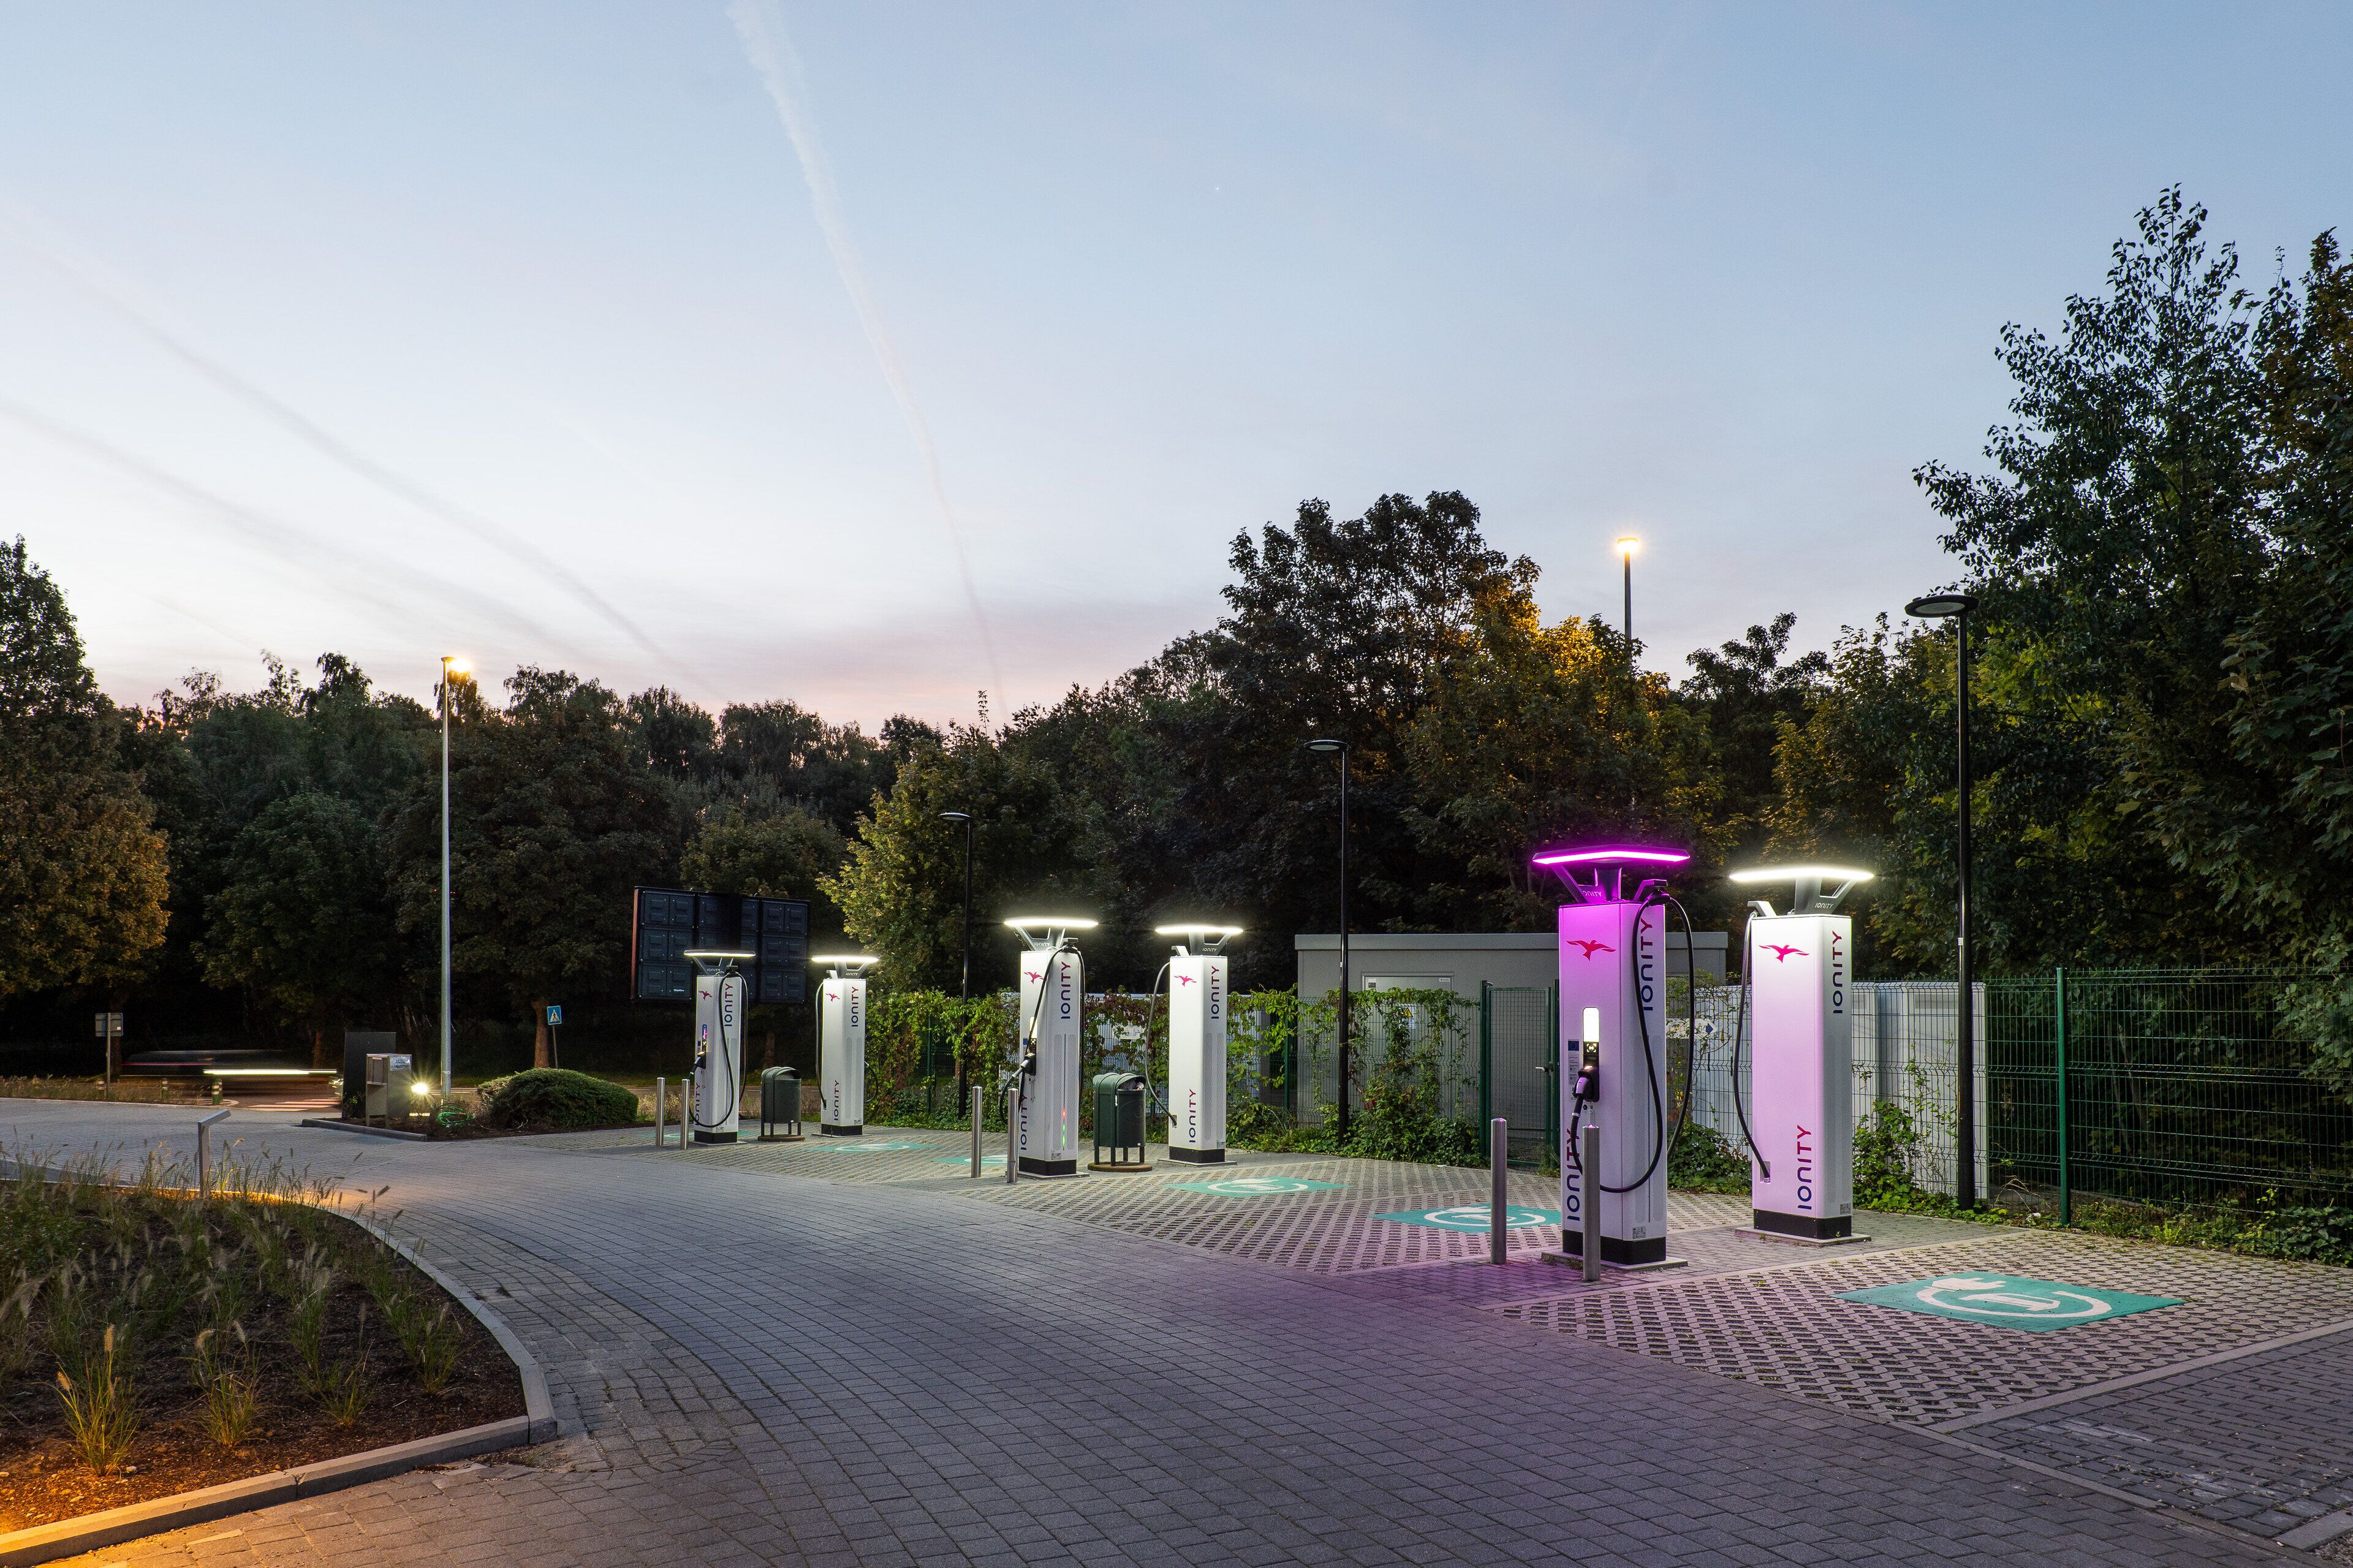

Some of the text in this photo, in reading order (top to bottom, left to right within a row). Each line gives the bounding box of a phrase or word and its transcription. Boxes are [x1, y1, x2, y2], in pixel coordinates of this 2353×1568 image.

[724, 983, 733, 1027] IONITY
[1061, 961, 1071, 1019] IONITY
[1211, 966, 1220, 1019] IONITY
[1640, 917, 1653, 1011] IONITY
[1832, 930, 1843, 1014] IONITY
[1566, 1128, 1580, 1221] IONITY
[1797, 1124, 1812, 1210] IONITY
